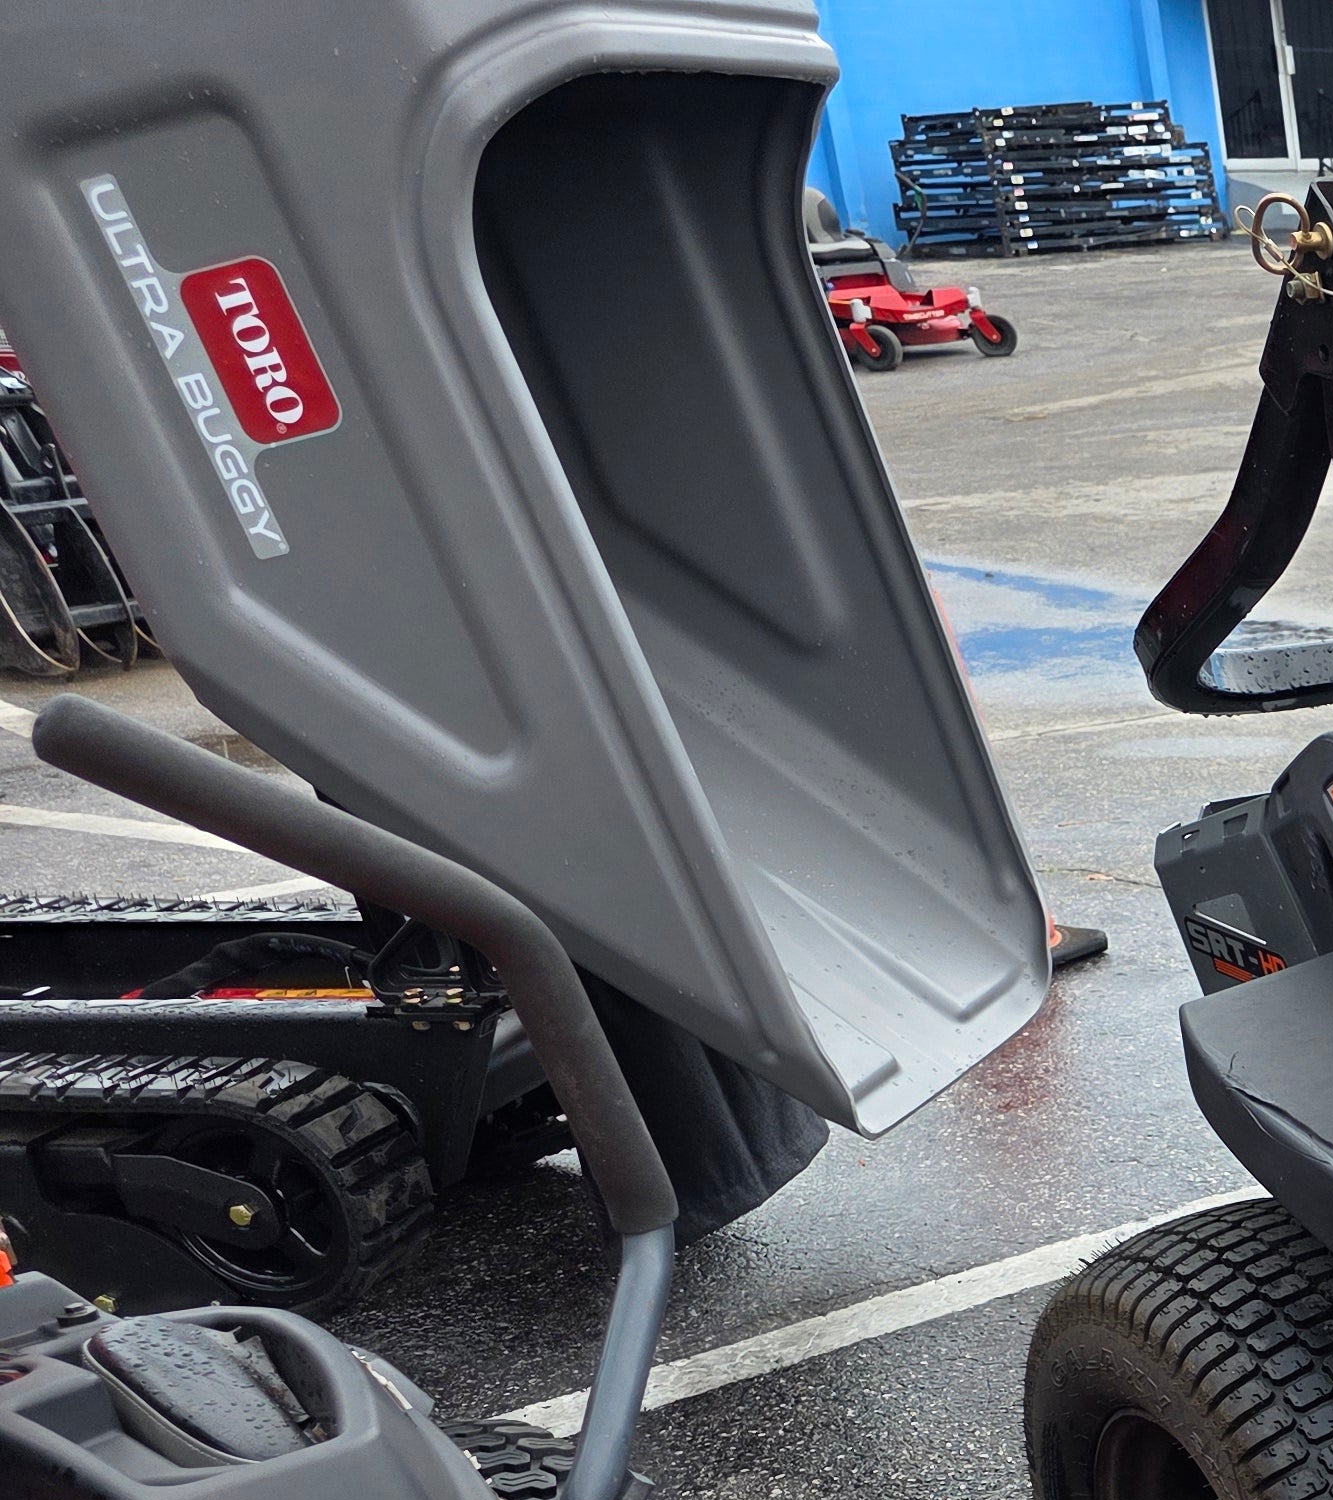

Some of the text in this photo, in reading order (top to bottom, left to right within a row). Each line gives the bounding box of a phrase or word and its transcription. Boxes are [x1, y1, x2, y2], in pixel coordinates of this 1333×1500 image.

[91, 183, 282, 542] ULTRA BUGGY
[214, 276, 304, 424] TORO
[1186, 920, 1286, 976] SRT-HD
